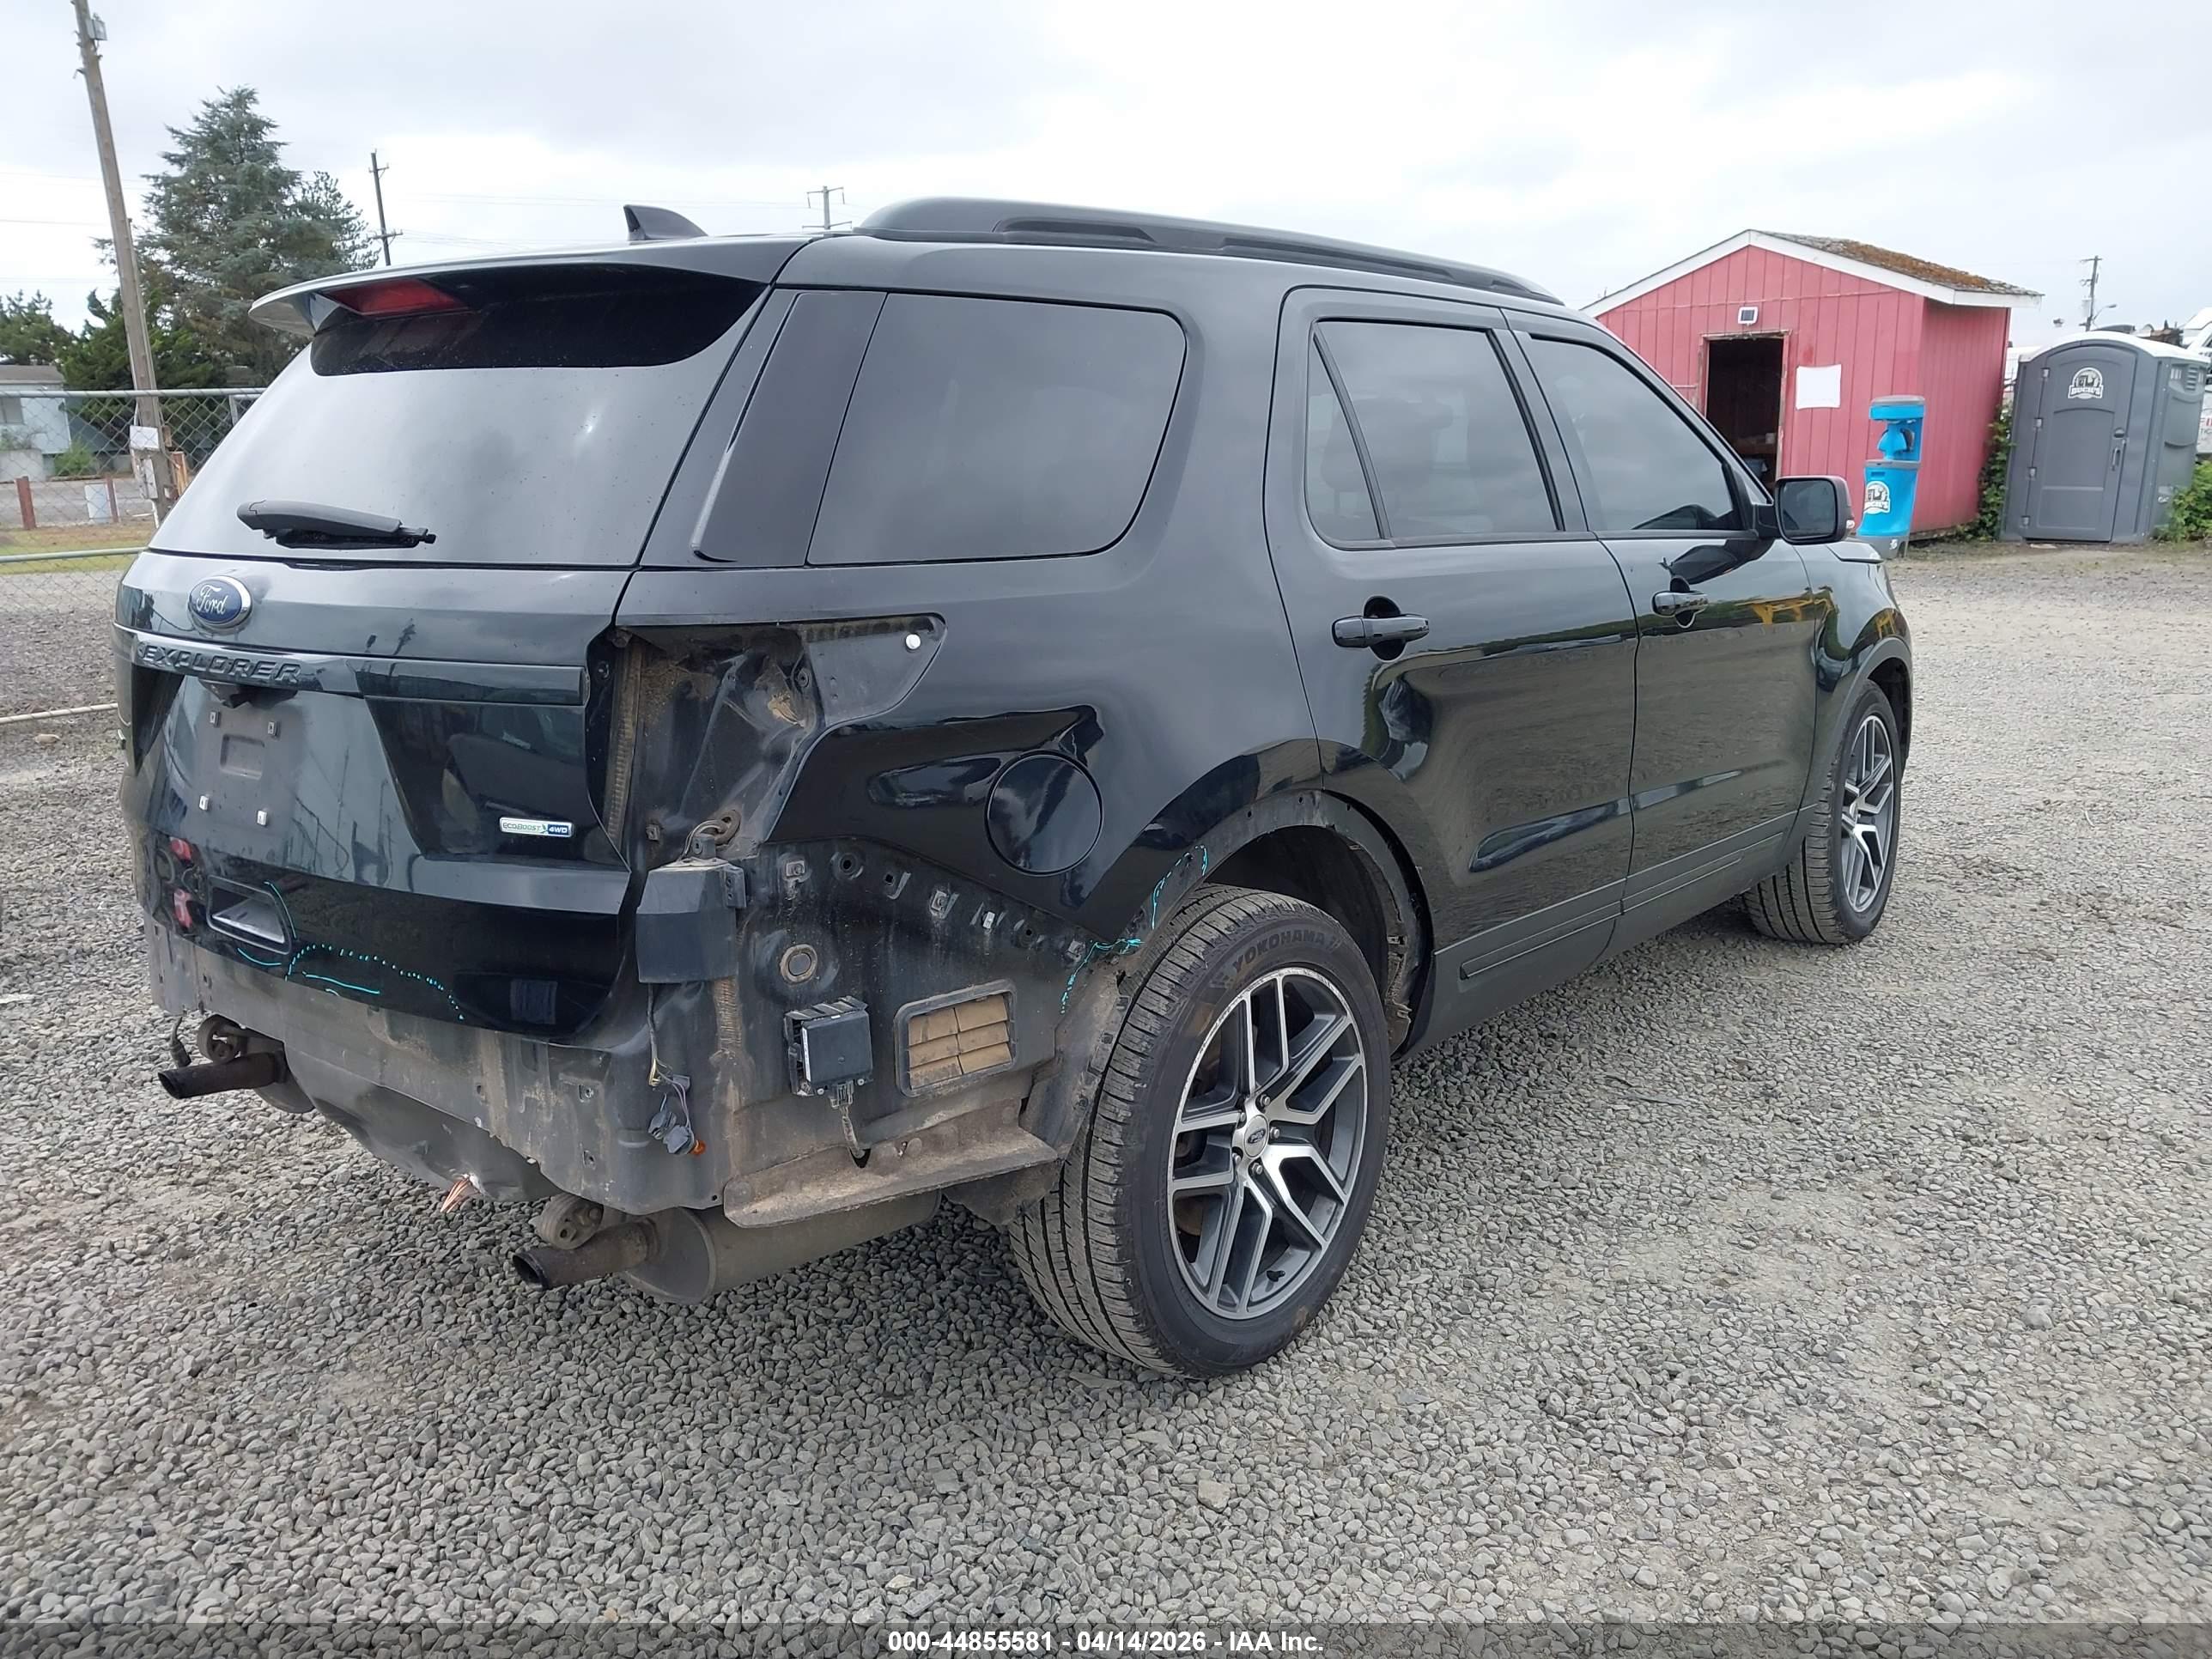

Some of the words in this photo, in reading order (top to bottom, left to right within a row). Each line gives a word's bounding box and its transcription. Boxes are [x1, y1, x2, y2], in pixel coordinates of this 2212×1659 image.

[196, 584, 228, 616] Ford
[141, 644, 302, 684] EXPLORER
[1233, 929, 1326, 971] YOKOHAMA
